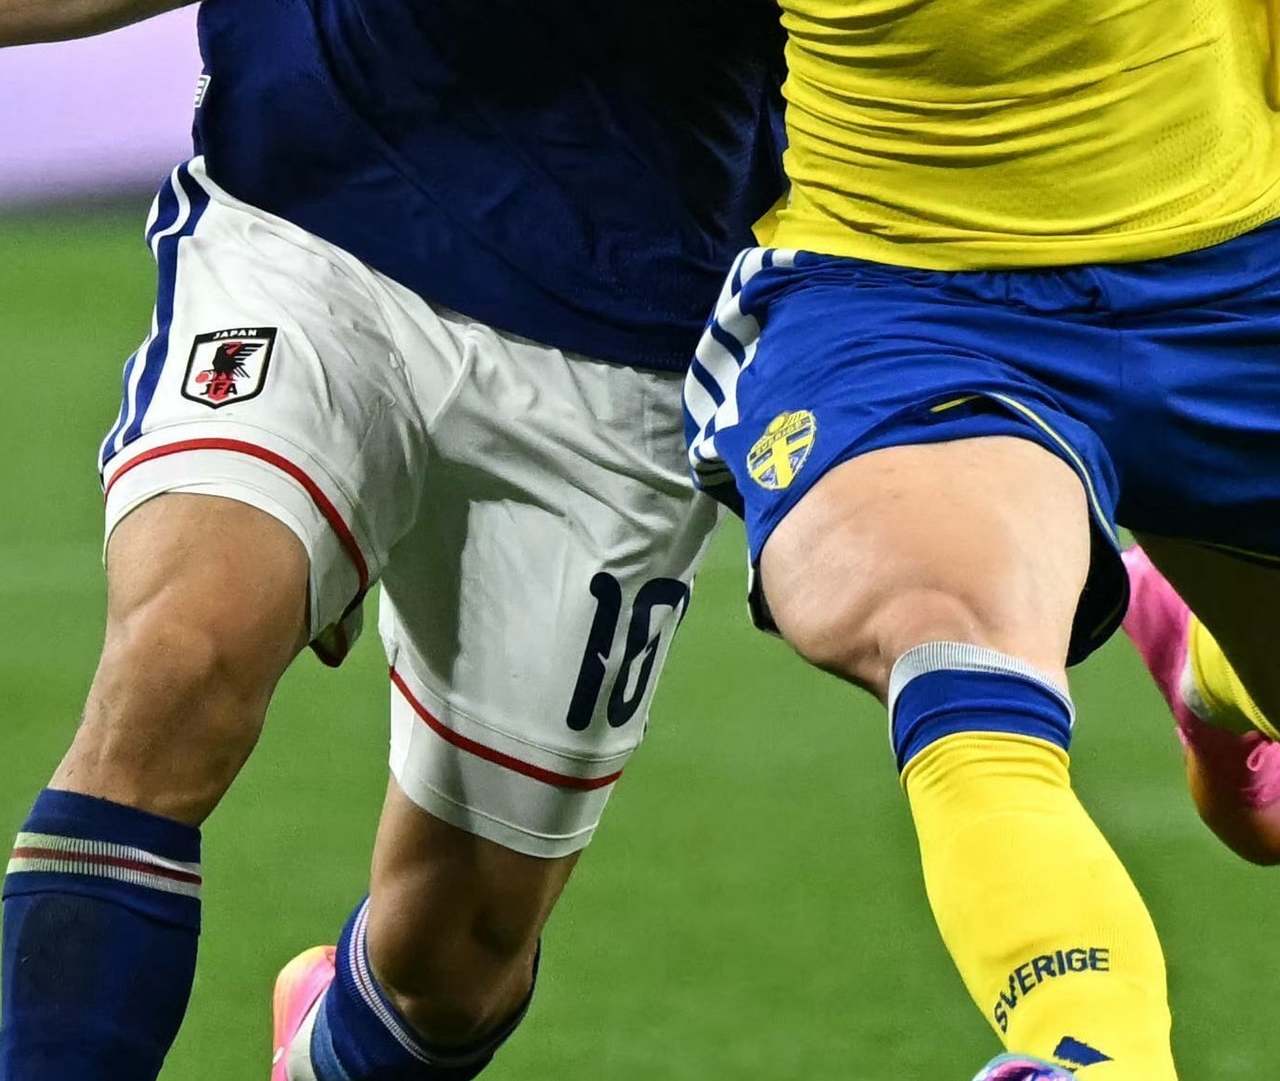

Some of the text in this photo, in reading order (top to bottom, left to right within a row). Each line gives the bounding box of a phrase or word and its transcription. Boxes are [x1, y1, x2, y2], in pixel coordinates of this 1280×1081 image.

[212, 329, 258, 340] JAPAN
[199, 381, 238, 396] JFA
[566, 572, 691, 731] 10
[994, 947, 1110, 1034] SVERIGE
